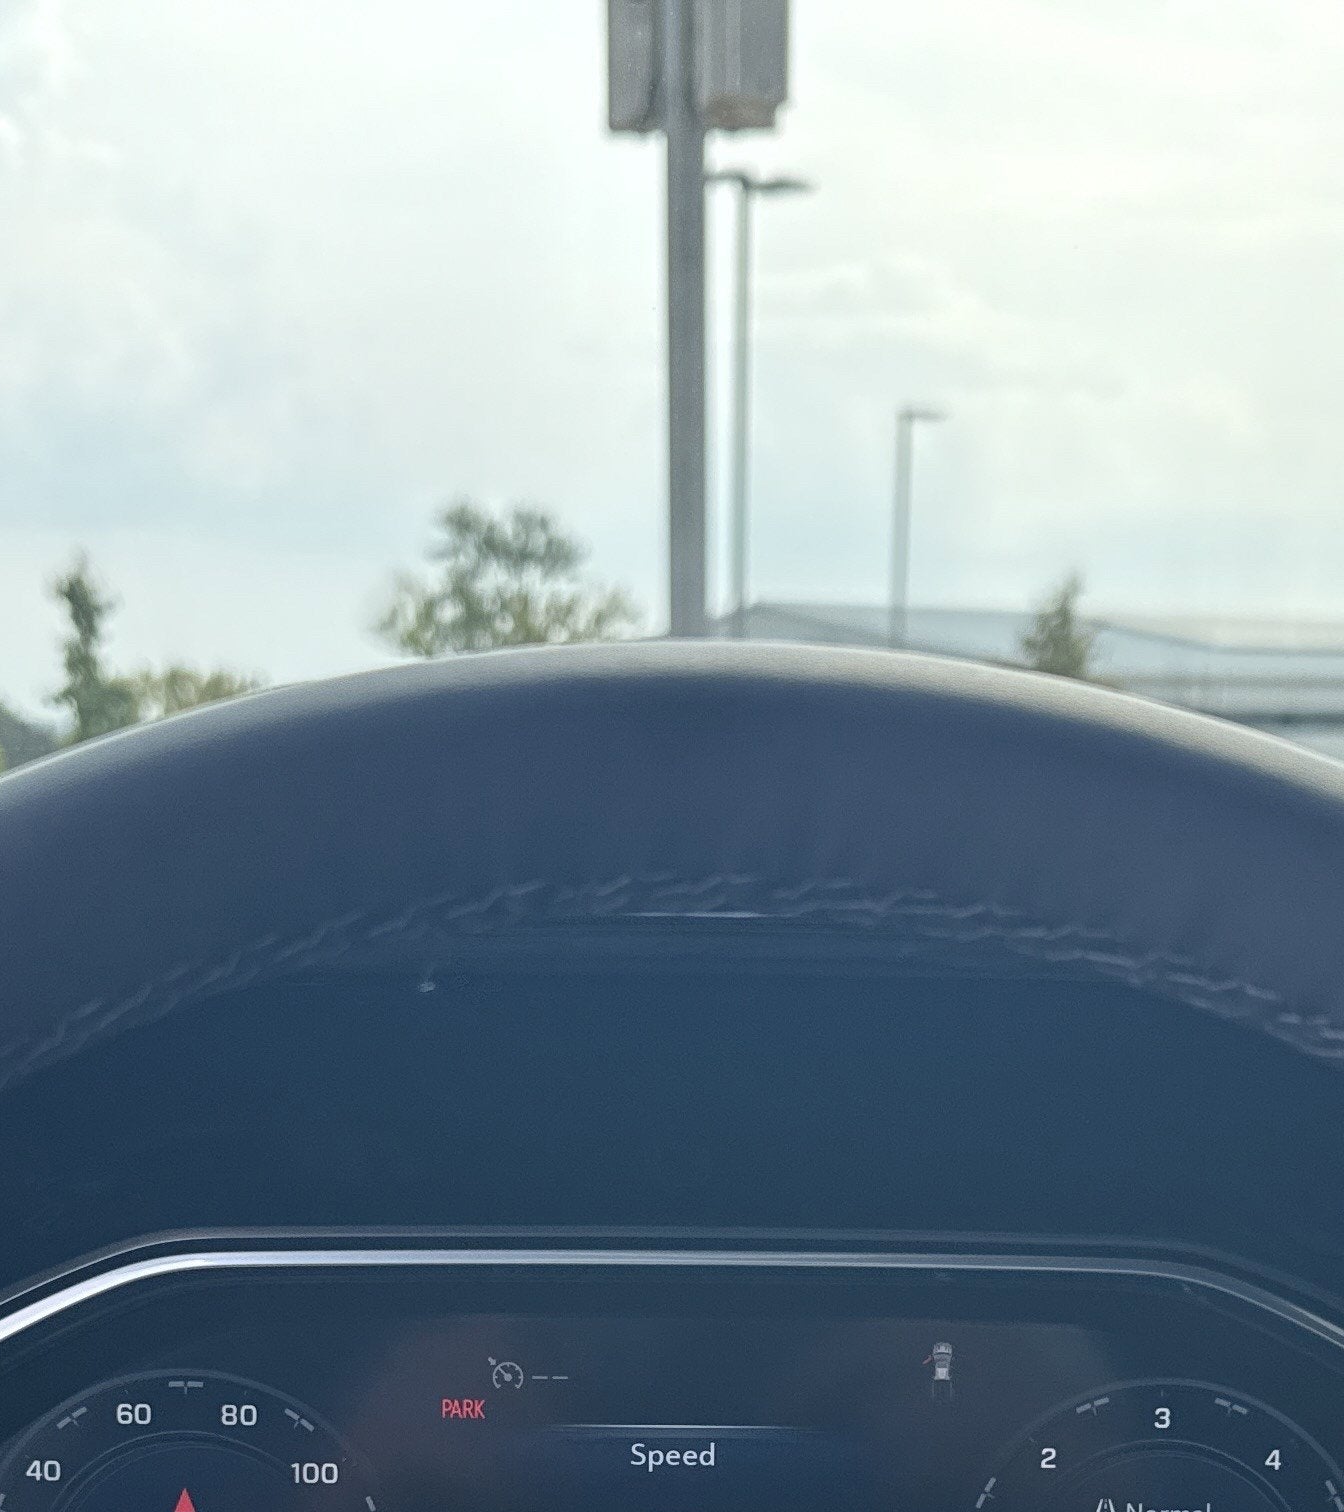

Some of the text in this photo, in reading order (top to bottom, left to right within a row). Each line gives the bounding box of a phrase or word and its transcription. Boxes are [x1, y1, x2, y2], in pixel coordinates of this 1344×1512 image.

[116, 1402, 152, 1426] 60
[220, 1404, 258, 1427] 80
[441, 1399, 486, 1420] PARK
[1154, 1407, 1172, 1430] 3
[629, 1441, 717, 1473] Speed
[1040, 1447, 1057, 1470] 2
[1264, 1449, 1283, 1471] 4
[25, 1459, 62, 1484] 40
[291, 1461, 340, 1486] 100
